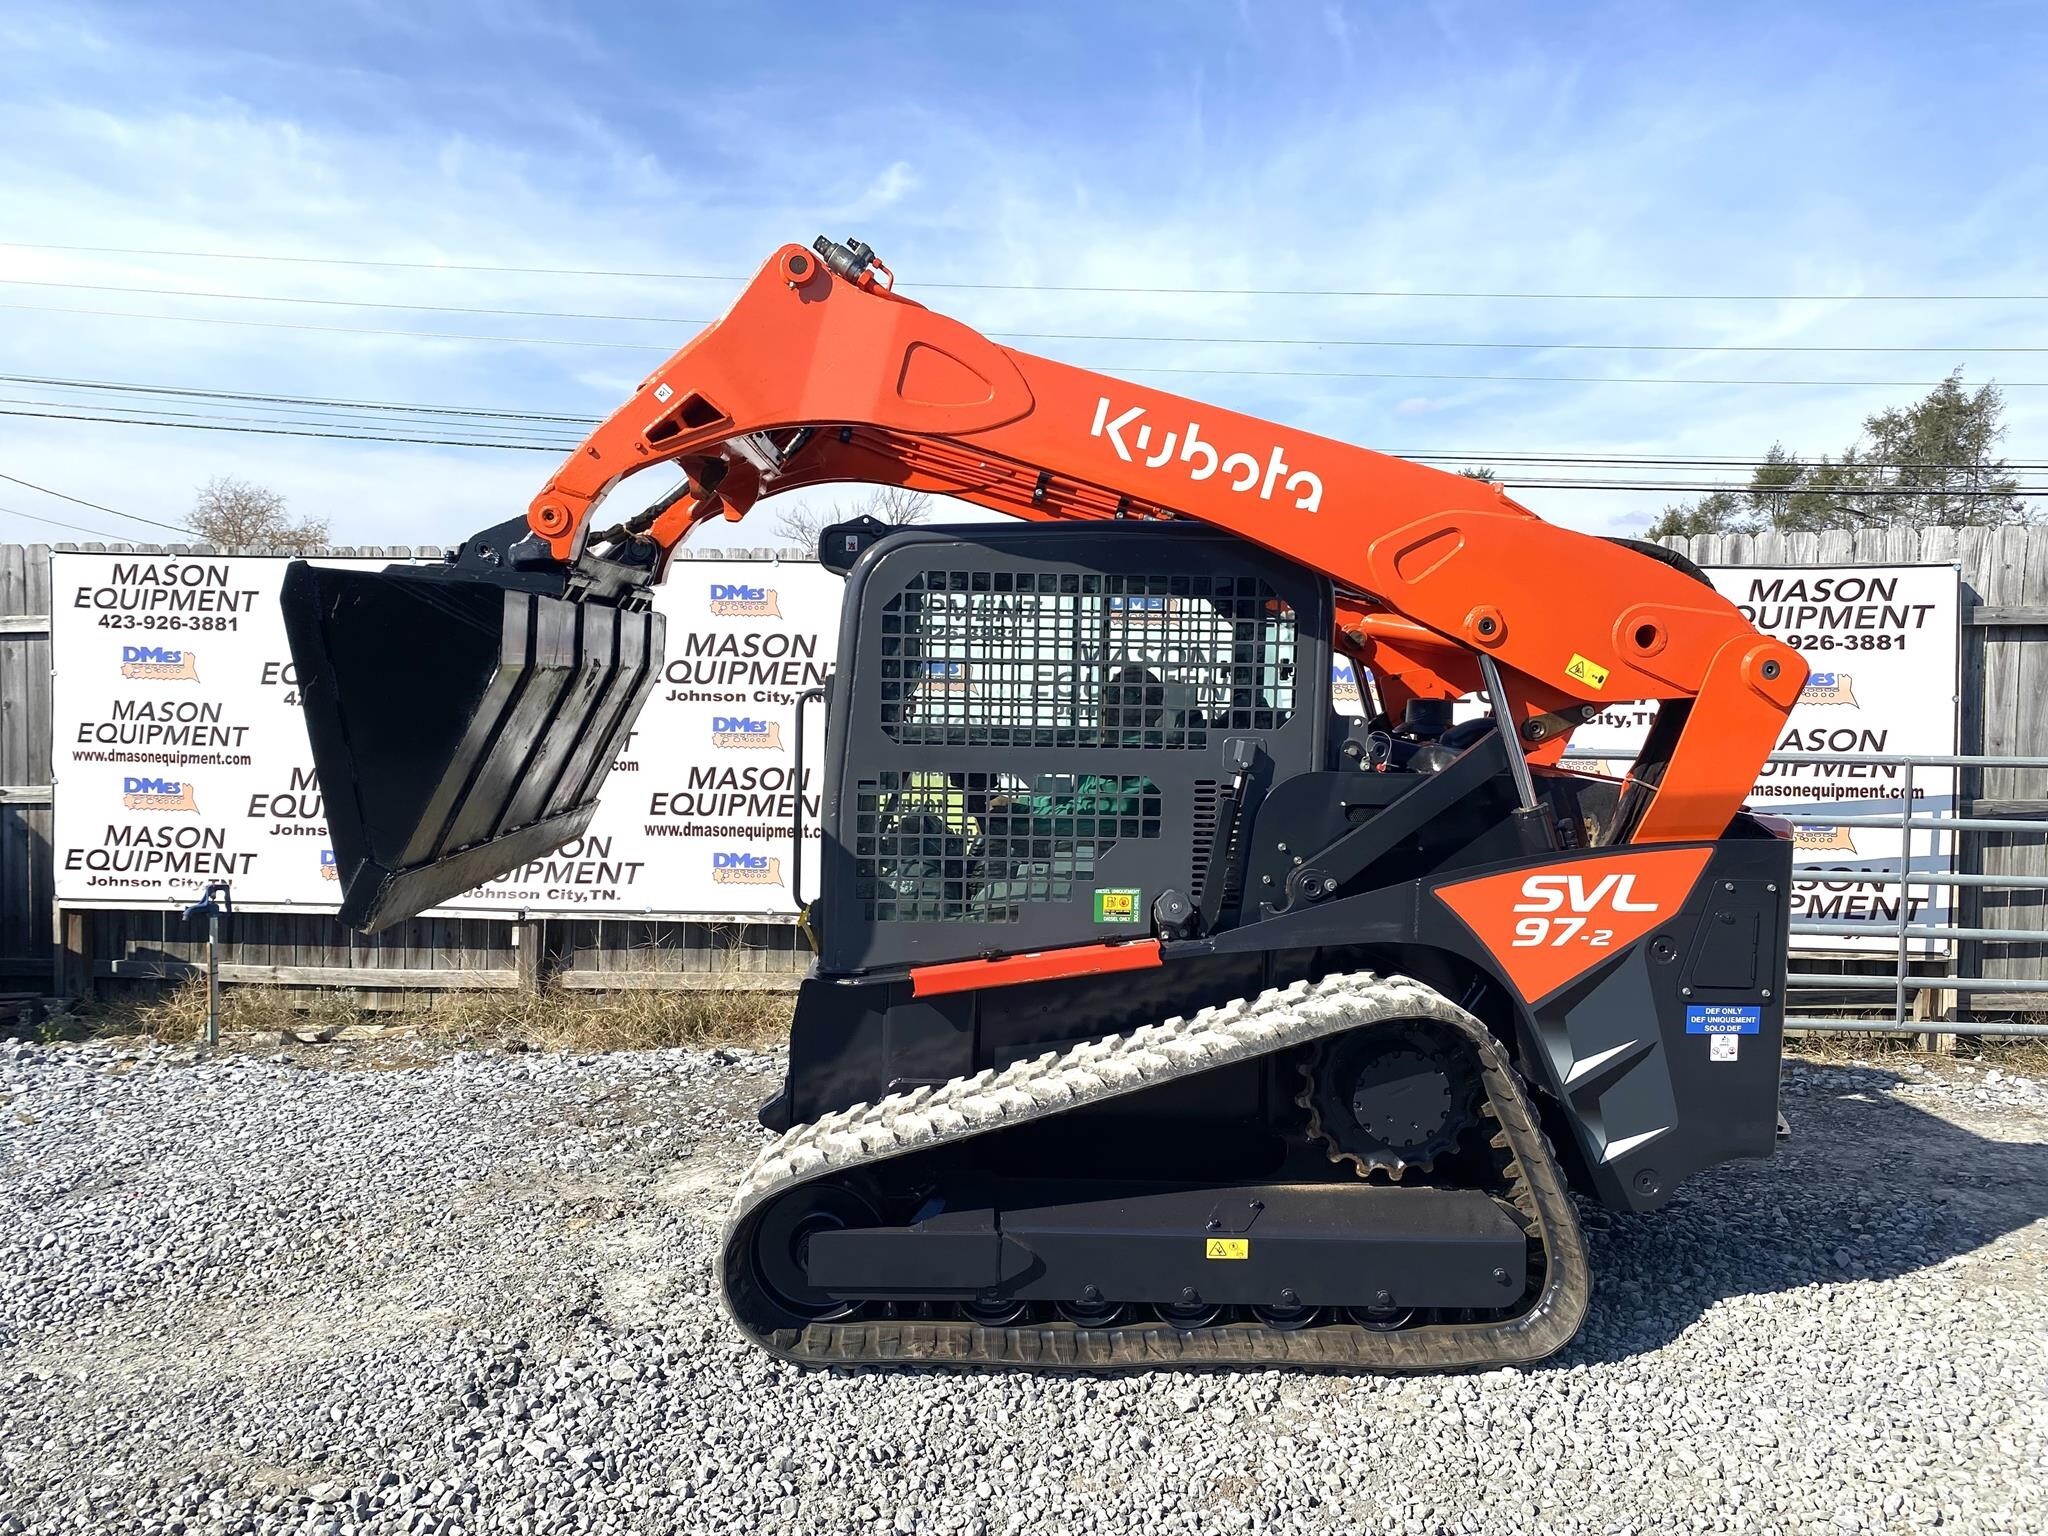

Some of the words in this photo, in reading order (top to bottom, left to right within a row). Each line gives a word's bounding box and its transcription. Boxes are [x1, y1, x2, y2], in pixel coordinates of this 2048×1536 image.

[1090, 396, 1323, 513] Kubota
[111, 563, 229, 587] MASON
[74, 587, 260, 612] EQUIPMENT
[1748, 578, 1898, 602] MASON
[98, 614, 238, 631] 423-926-3881
[1736, 604, 1936, 629] UIPMENT
[685, 632, 817, 658] MASON
[1771, 634, 1906, 650] 926-3881
[655, 659, 836, 686] QUIPMEN
[665, 690, 746, 703] Johnson
[112, 700, 222, 723] MASON
[1583, 712, 1658, 728] City,T
[77, 722, 249, 747] EQUIPMENT
[1773, 728, 1888, 752] ASON
[72, 749, 251, 767] www.dmasonequipment.com
[688, 766, 810, 791] MASON
[1750, 783, 1924, 801] masonequipment.cm
[650, 792, 820, 818] EQUIPMEN
[104, 825, 225, 849] MASON
[269, 824, 328, 836] Johns
[644, 821, 821, 841] www.dmasonequipmet.c
[65, 849, 258, 874] EQUIPMENT
[491, 861, 644, 885] IPMENT
[86, 876, 162, 888] Johnson
[1513, 874, 1659, 913] SVL
[462, 888, 540, 900] Johnson
[547, 888, 621, 902] City,TN.
[1790, 894, 1929, 922] PMENT
[1511, 917, 1614, 947] 97-2
